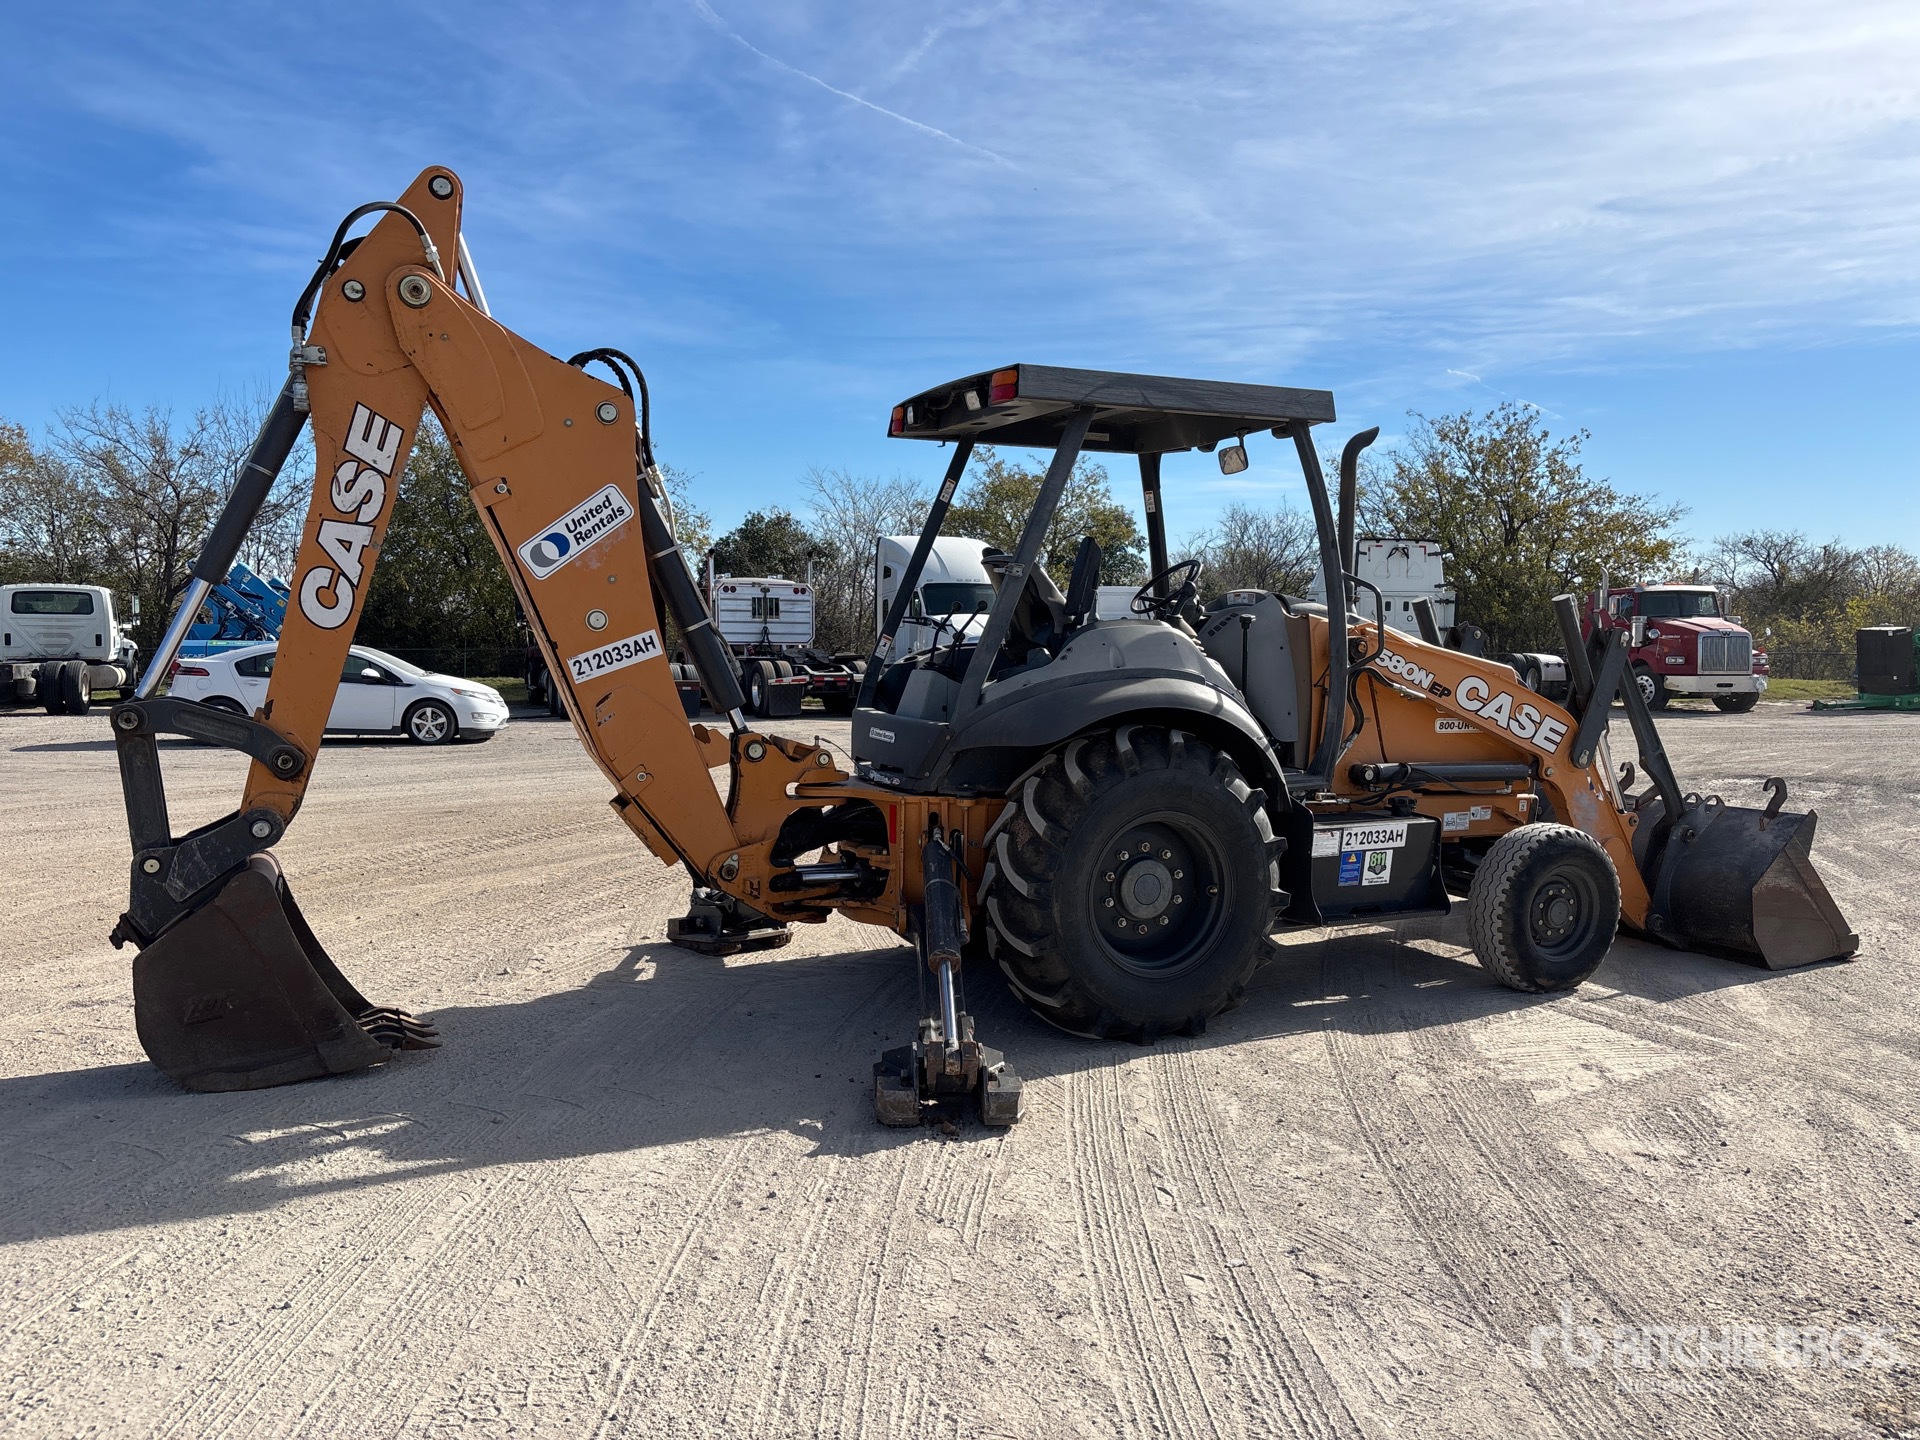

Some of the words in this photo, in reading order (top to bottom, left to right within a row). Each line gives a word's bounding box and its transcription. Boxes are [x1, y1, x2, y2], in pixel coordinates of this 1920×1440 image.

[299, 401, 404, 629] CASE
[565, 496, 613, 534] United
[573, 506, 625, 546] Rentals
[572, 635, 657, 676] 212033AH
[1438, 721, 1478, 730] 800-UR-
[1455, 675, 1569, 754] CASE
[1345, 828, 1404, 846] 212033AH
[1369, 851, 1387, 867] 811
